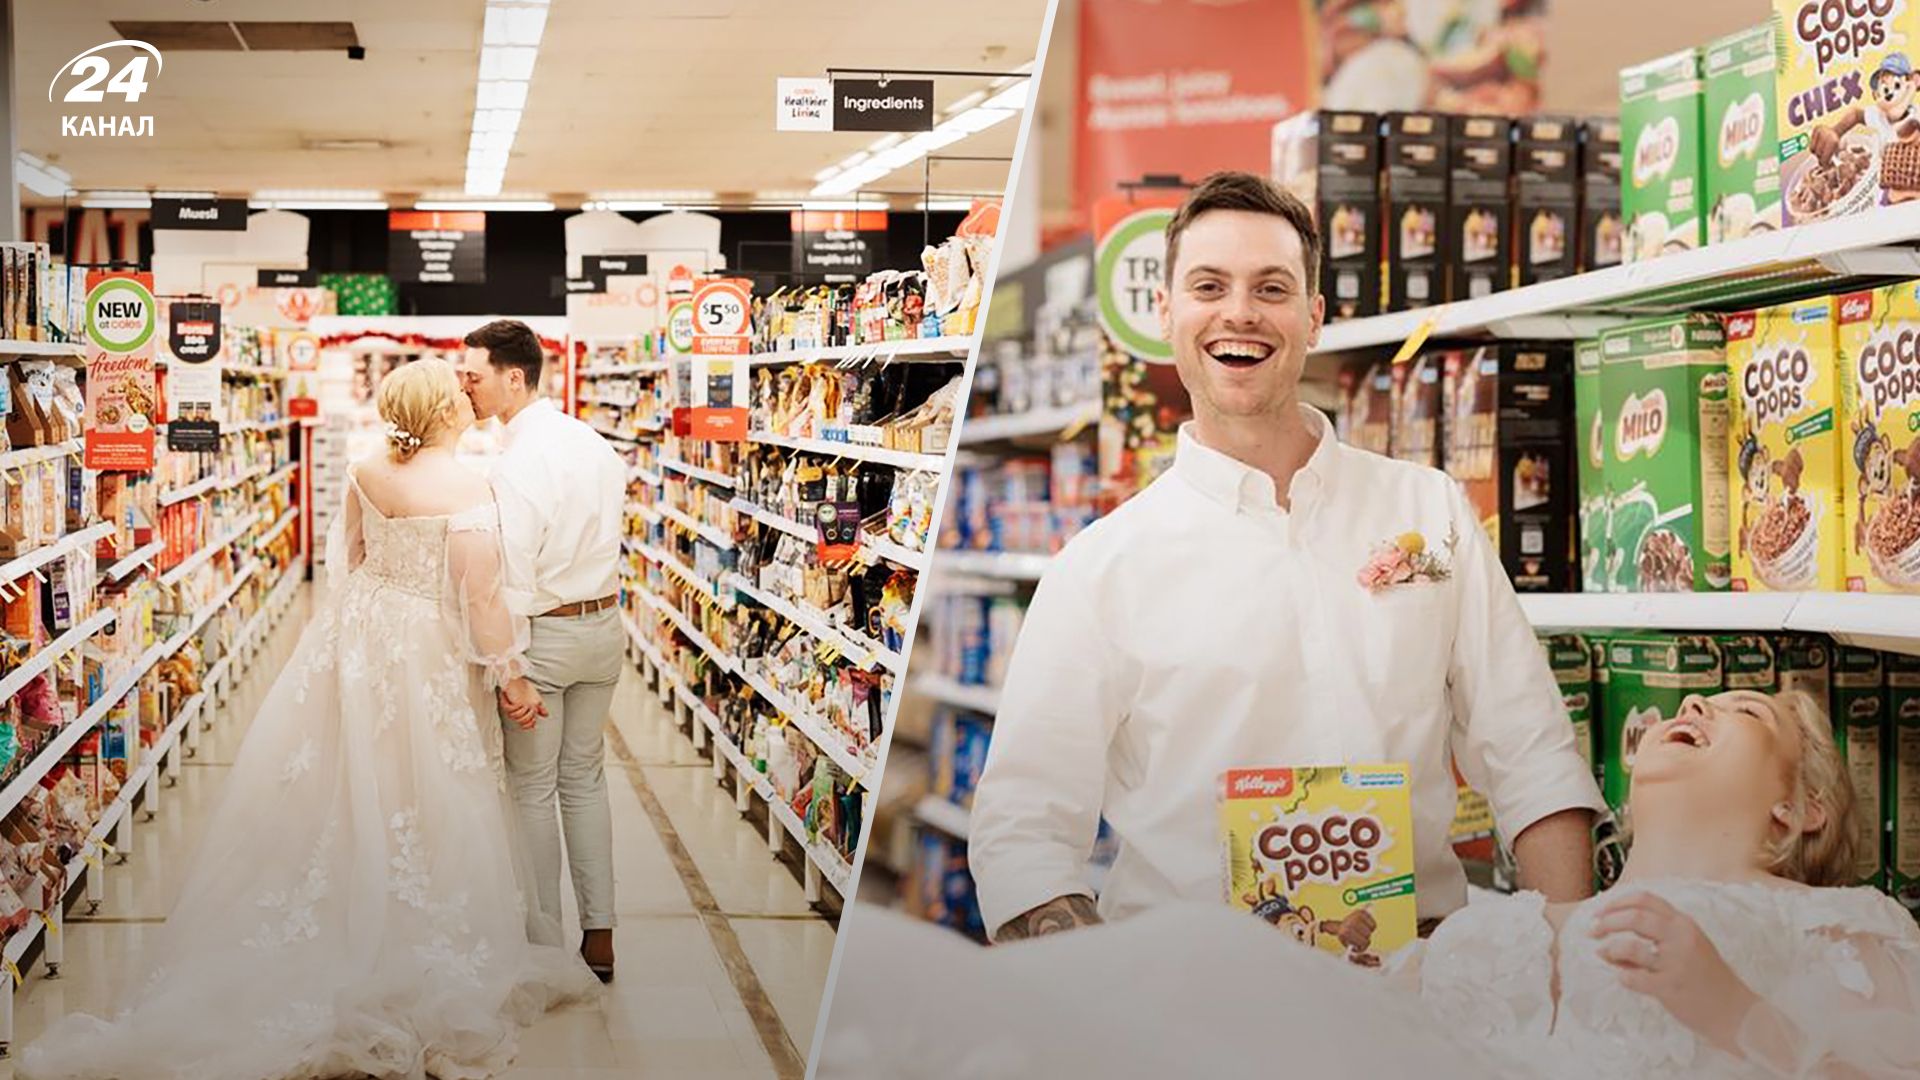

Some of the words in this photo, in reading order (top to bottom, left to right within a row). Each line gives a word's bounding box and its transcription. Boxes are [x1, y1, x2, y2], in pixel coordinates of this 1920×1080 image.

[1816, 20, 1885, 74] pops
[784, 95, 828, 107] Healthier
[791, 107, 821, 119] Living
[843, 95, 925, 112] Ingredients
[1788, 71, 1863, 127] CHEX
[1725, 113, 1759, 146] MILO
[178, 205, 219, 220] Muesli
[98, 301, 143, 319] NEW
[99, 319, 110, 330] at
[110, 319, 143, 330] coles
[88, 352, 154, 379] freedom
[1744, 350, 1808, 398] COCO
[1756, 385, 1802, 429] pops
[1622, 408, 1662, 445] MILO
[1234, 774, 1287, 795] Kellogg's
[1258, 815, 1381, 860] COCO
[1284, 848, 1371, 891] pops
